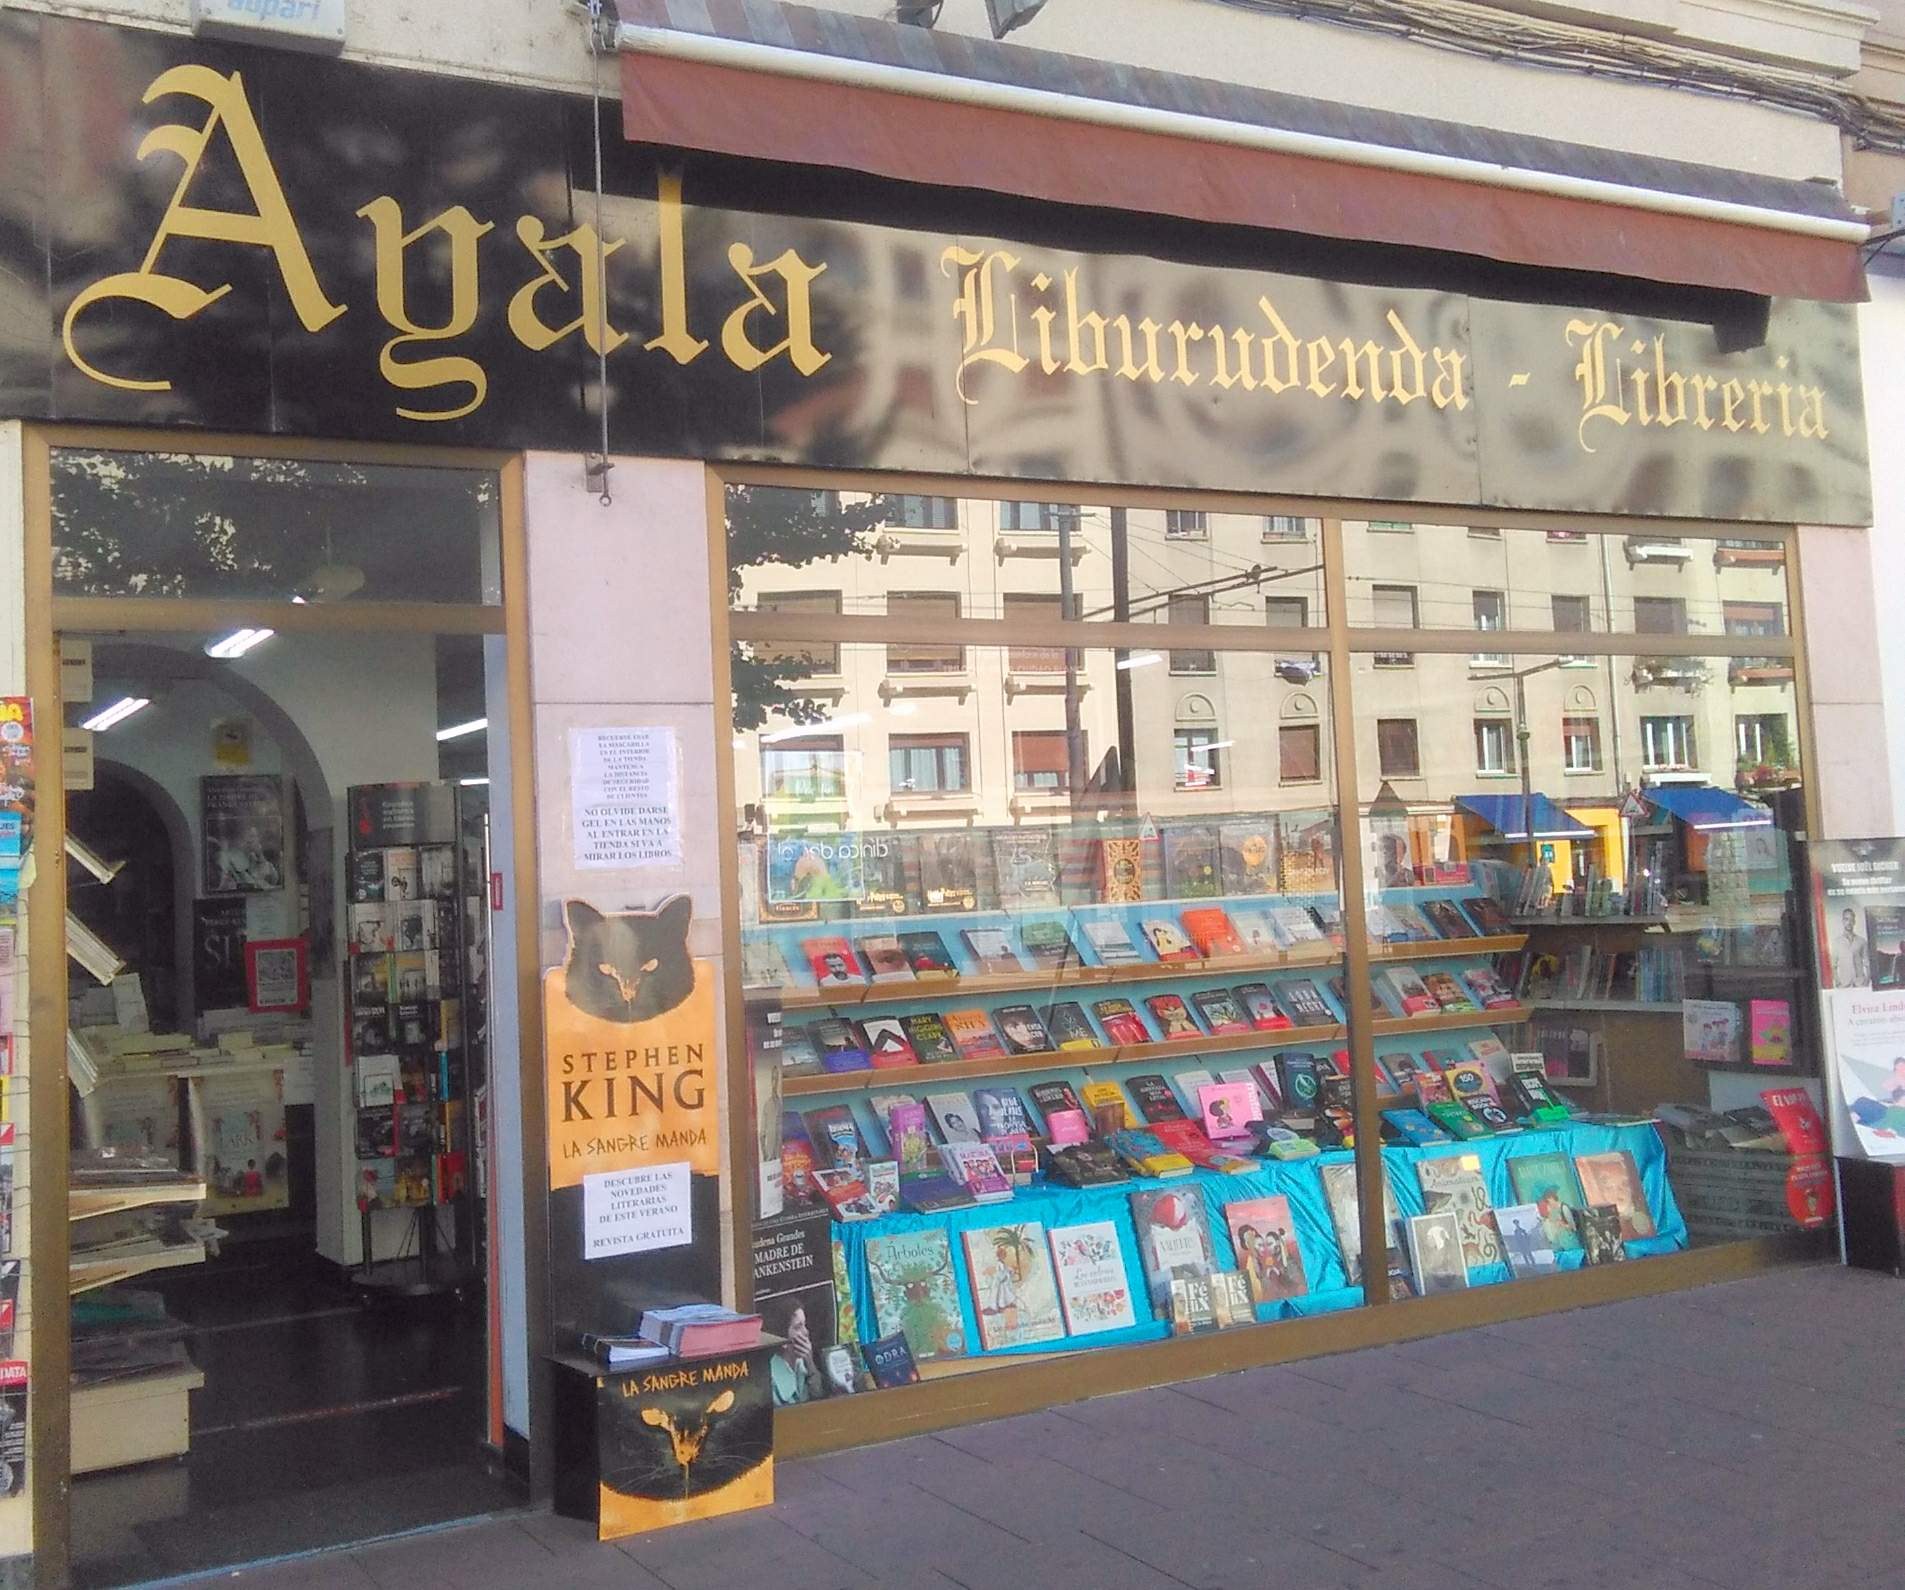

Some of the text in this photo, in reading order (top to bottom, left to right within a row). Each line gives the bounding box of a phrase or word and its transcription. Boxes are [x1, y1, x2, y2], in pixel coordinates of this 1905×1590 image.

[62, 65, 831, 421] Ayala
[941, 245, 1468, 406] Liburudenda
[1566, 319, 1829, 453] Libreria
[584, 806, 668, 816] NO OLVIDE DARSE
[582, 817, 671, 828] GEL EN LAS MANOS
[587, 828, 669, 839] AL ENTRAR EN LA
[593, 840, 628, 849] TIENDA
[584, 849, 672, 861] MIRAR LOS LIBROS
[562, 1043, 704, 1075] STEPHEN
[562, 1069, 705, 1123] KING
[563, 1128, 707, 1160] LA SANGRE MANDA
[603, 1171, 673, 1189] DESCUBRE LAS
[610, 1184, 667, 1198] NOVEDADES
[610, 1195, 667, 1211] LITERARIAS
[599, 1205, 678, 1224] DE ESTE VERANO
[593, 1227, 685, 1249] REVISTA GRATUITA
[776, 1229, 806, 1244] Grandes
[754, 1243, 805, 1265] MADRE DE
[622, 1360, 749, 1397] LA SANGRE MANDA
